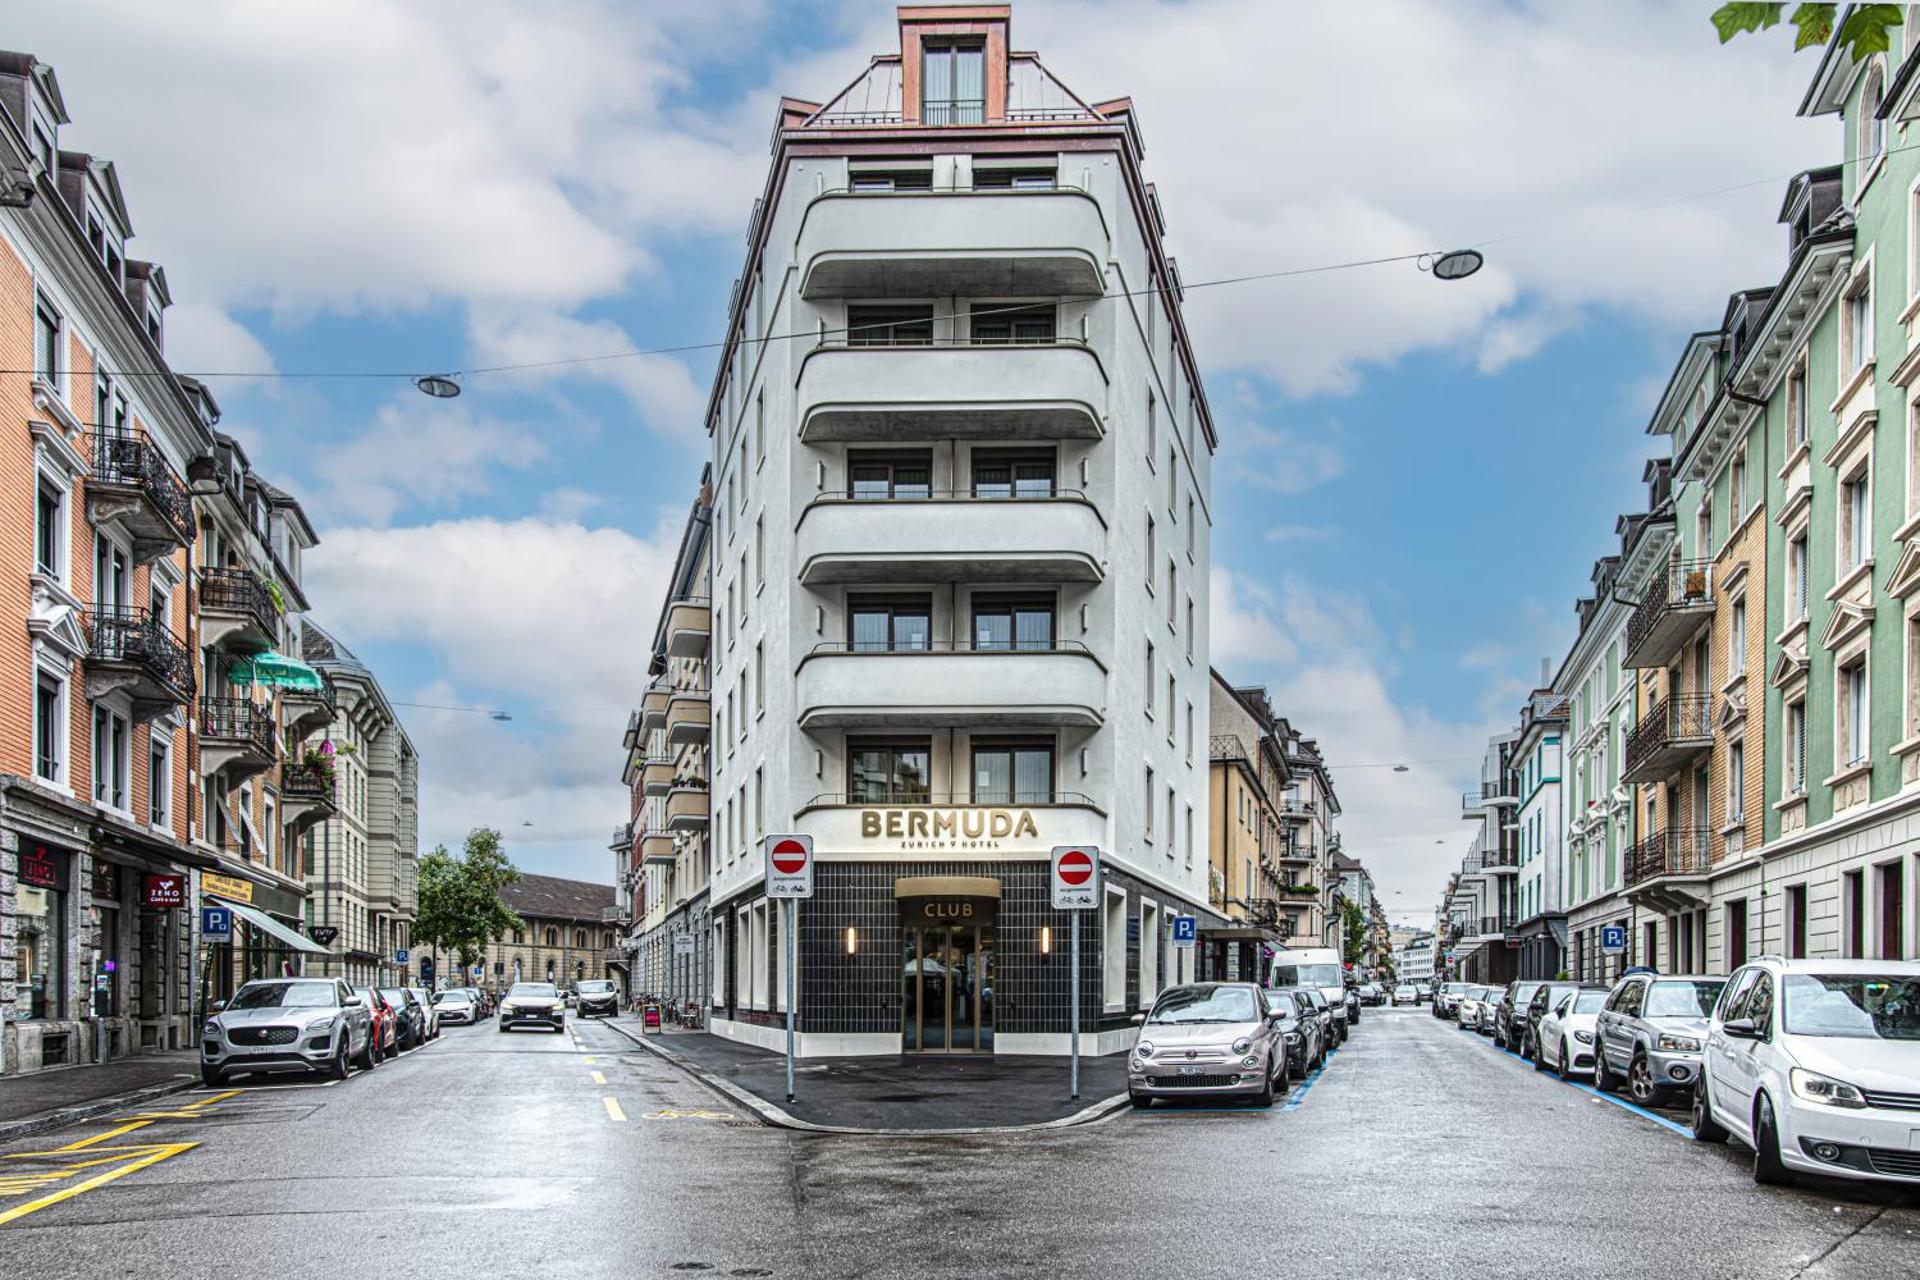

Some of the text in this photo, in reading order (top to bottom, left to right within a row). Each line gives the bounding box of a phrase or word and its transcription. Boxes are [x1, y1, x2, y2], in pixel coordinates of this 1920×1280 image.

[862, 810, 1038, 837] BERMUDA
[924, 903, 973, 917] CLUB
[209, 912, 222, 930] P
[1179, 921, 1190, 936] P
[1608, 931, 1617, 944] P
